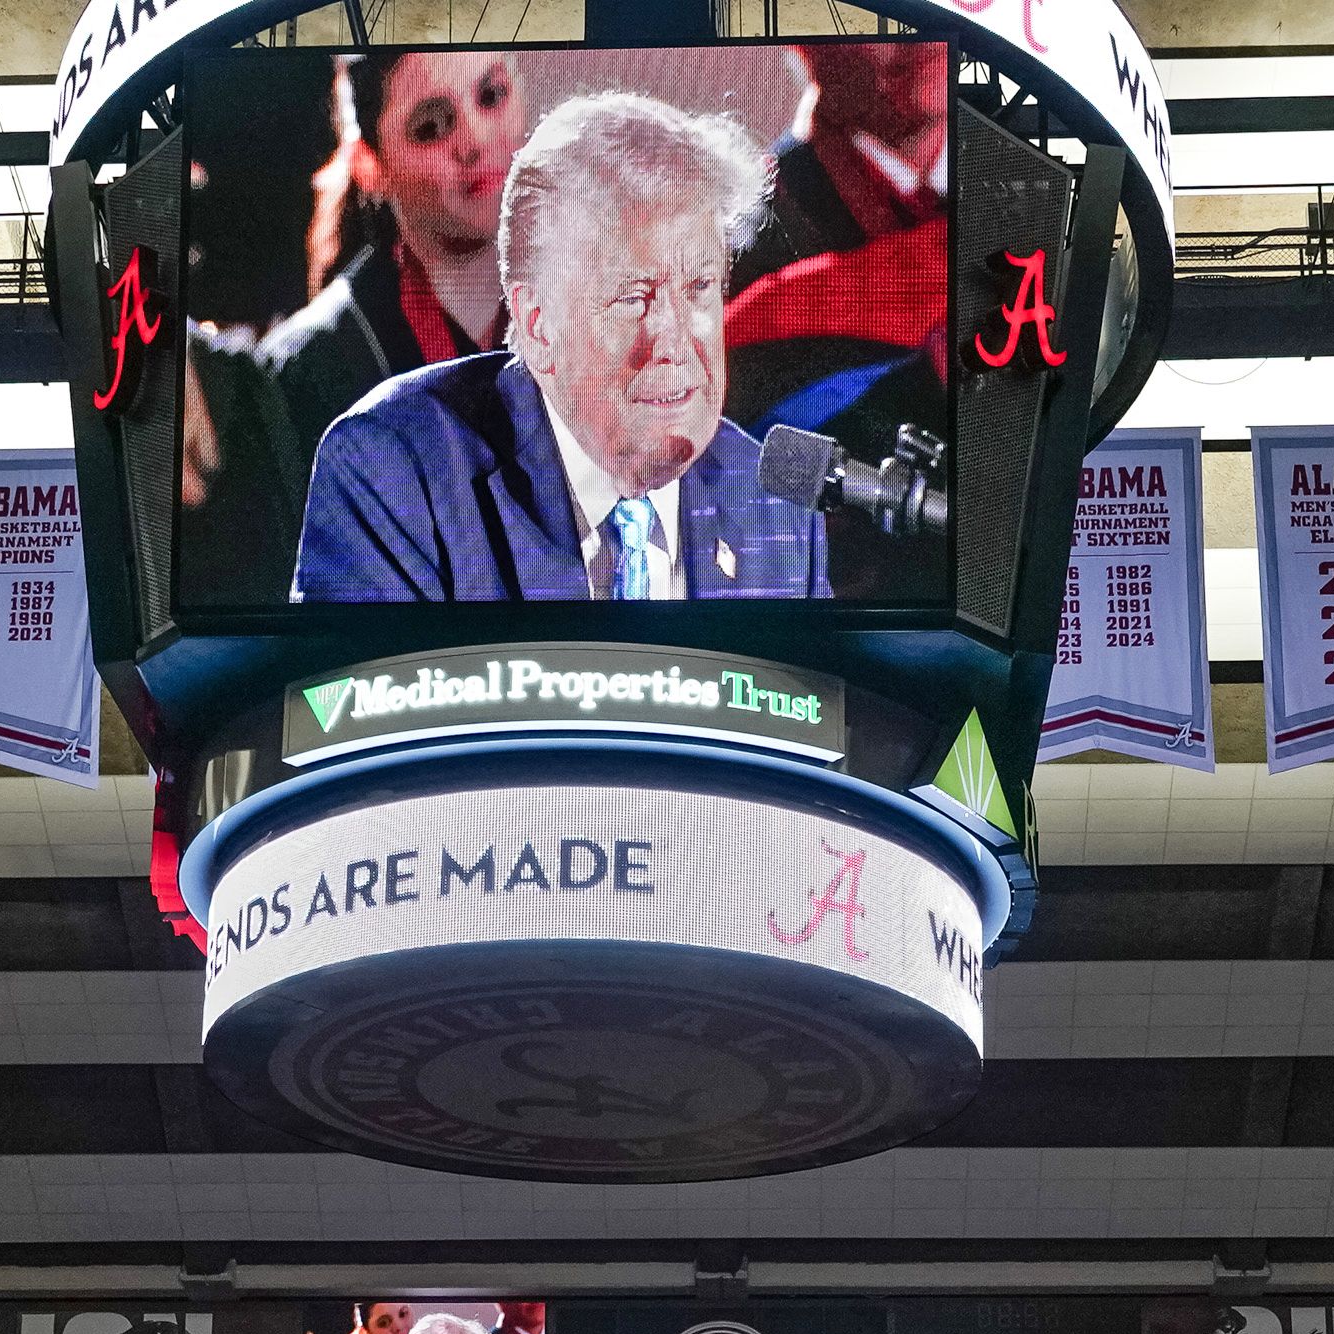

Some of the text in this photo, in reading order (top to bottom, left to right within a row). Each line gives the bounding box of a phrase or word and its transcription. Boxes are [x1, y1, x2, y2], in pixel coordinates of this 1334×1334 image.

[974, 248, 1067, 367] A
[1078, 466, 1167, 498] BAMA
[1077, 503, 1168, 516] ASKETBALL
[1073, 517, 1170, 530] OURNAMENT
[1290, 515, 1333, 527] NCAA
[1087, 531, 1170, 547] SIXTEEN
[1106, 564, 1152, 580] 1982
[11, 581, 55, 595] 1934
[1106, 582, 1152, 597] 1986
[10, 596, 54, 610] 1987
[1107, 598, 1151, 613] 1991
[9, 612, 53, 625] 1990
[1060, 615, 1152, 631] 04 2021
[8, 627, 52, 641] 2021
[1058, 632, 1155, 647] 23 2024
[1055, 651, 1082, 664] 25
[350, 660, 503, 718] Medical
[507, 660, 720, 710] Properties
[721, 670, 823, 724] Trust
[305, 849, 420, 926] ARE
[439, 838, 656, 899] MADE
